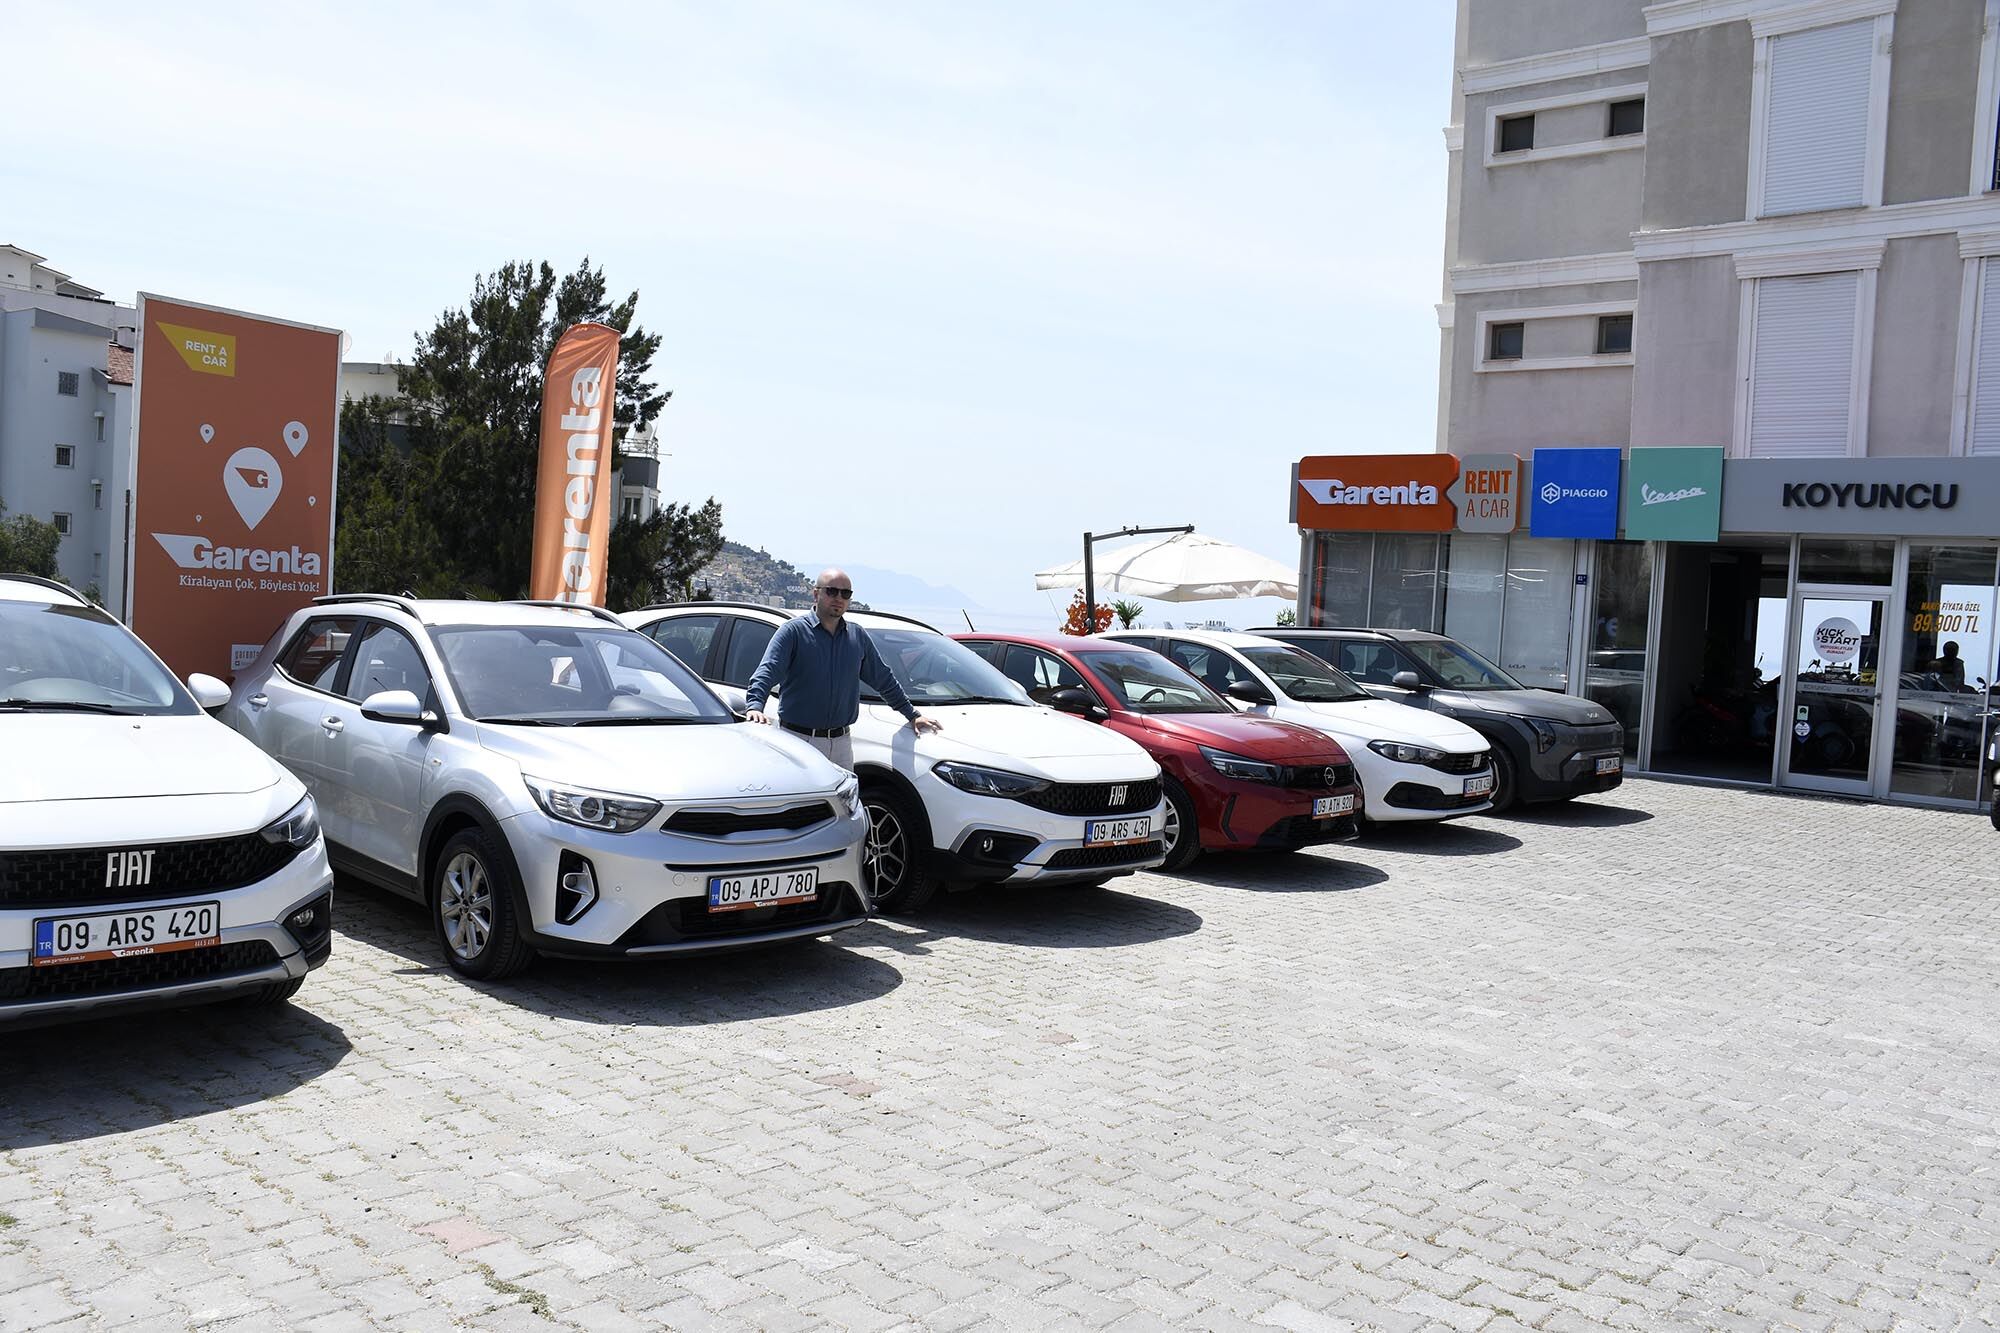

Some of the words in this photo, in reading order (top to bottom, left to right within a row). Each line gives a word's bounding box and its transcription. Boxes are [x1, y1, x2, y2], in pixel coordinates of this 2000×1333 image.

[185, 340, 217, 354] RENT
[218, 346, 228, 357] A
[202, 354, 227, 368] CAR
[1297, 479, 1438, 505] Garenta
[1465, 470, 1513, 495] RENT
[1562, 488, 1608, 498] PIAGGIO
[1641, 482, 1707, 506] Vespa
[1782, 482, 1959, 509] KOYUNCU
[1465, 499, 1476, 518] A
[1480, 498, 1509, 518] CAR
[151, 532, 321, 576] Garenta
[179, 575, 232, 590] Kiralayan
[235, 577, 257, 592] Çok,
[260, 576, 297, 593] Böylesi
[299, 581, 320, 593] Yok!
[1941, 600, 1964, 611] FİYATA
[1964, 601, 1981, 612] ÖZEL
[1816, 628, 1845, 637] KICK
[1912, 613, 1962, 633] 89.900
[1964, 615, 1979, 633] TL
[1820, 636, 1859, 646] START
[1108, 785, 1128, 806] FIAT
[1318, 800, 1326, 813] 09
[1093, 824, 1106, 840] 09
[1111, 822, 1129, 839] ARS
[1133, 820, 1148, 836] 431
[105, 850, 156, 888] FIAT
[722, 880, 741, 902] 09
[750, 876, 779, 899] APJ
[786, 873, 813, 894] 780
[39, 942, 51, 950] TR
[57, 922, 90, 951] 09
[107, 915, 155, 946] ARS
[168, 908, 211, 938] 420
[111, 947, 154, 958] Garenta
